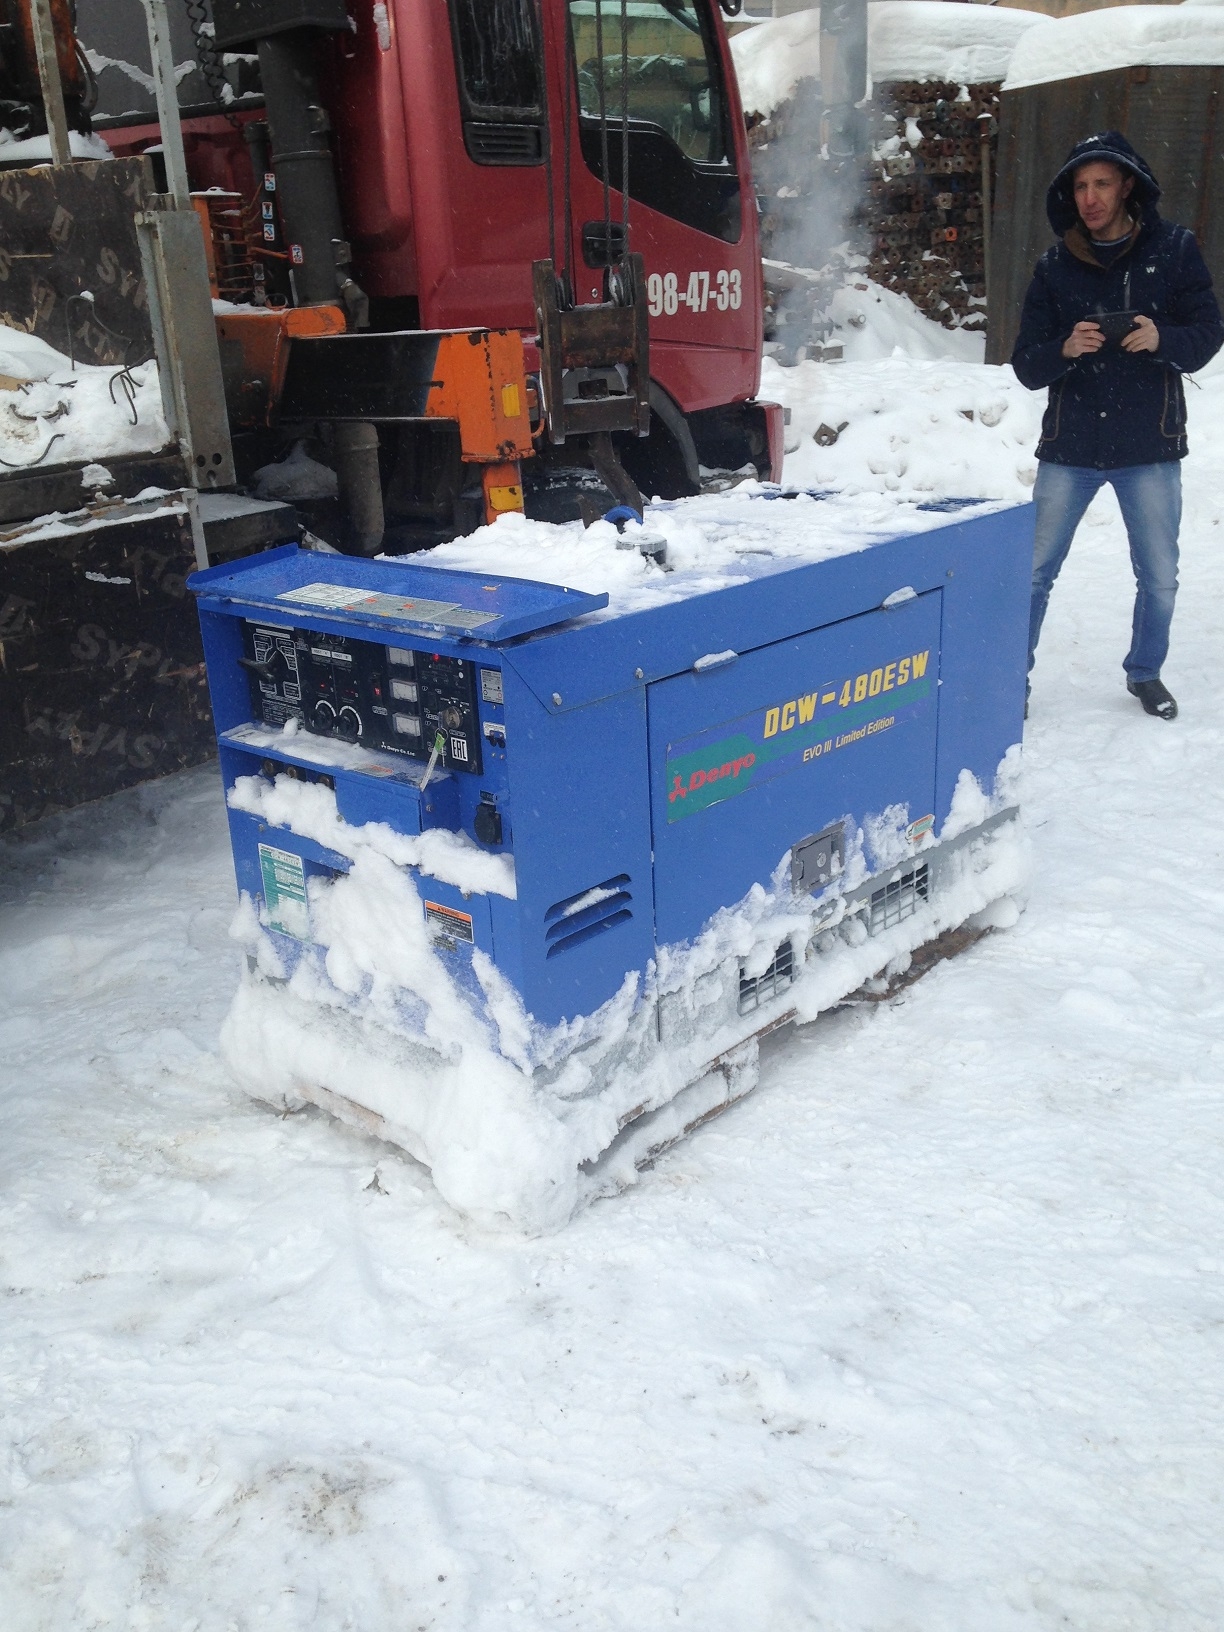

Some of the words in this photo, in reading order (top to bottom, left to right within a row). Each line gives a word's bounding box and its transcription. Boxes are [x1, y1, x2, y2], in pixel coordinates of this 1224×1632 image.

[645, 268, 742, 317] 98-47-33
[763, 650, 929, 739] DCW-480ESW
[803, 744, 823, 762] EVO
[835, 725, 867, 748] Limited
[867, 716, 895, 735] Edition
[688, 753, 756, 792] Denyo
